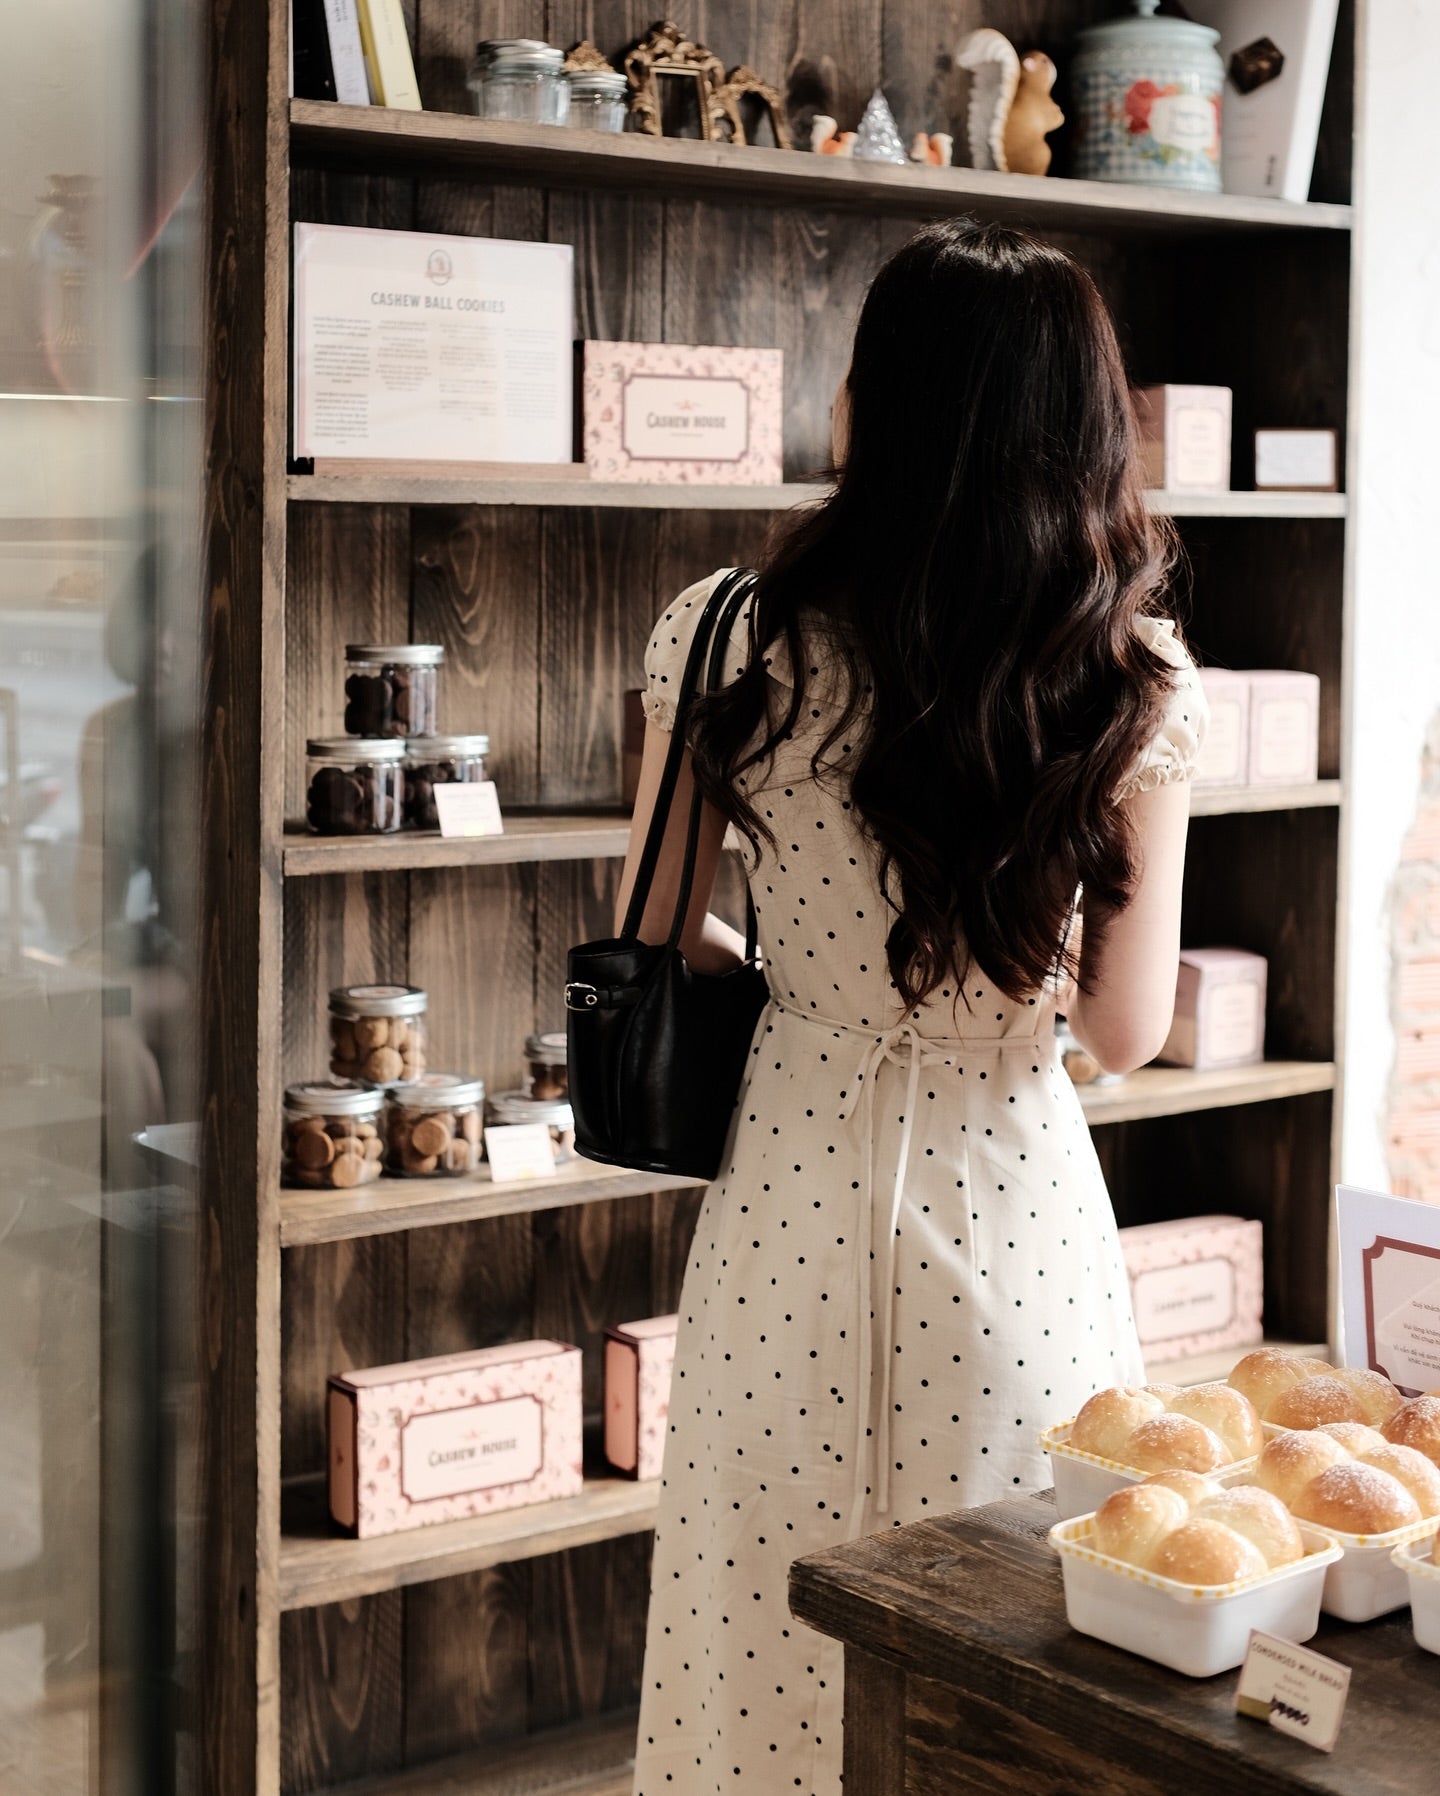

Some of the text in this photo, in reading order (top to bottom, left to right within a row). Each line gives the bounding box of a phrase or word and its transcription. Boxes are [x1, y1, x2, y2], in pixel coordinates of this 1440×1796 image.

[370, 291, 506, 314] CASHEW BALL COOKIES
[647, 411, 727, 429] CASHEW HOUSE
